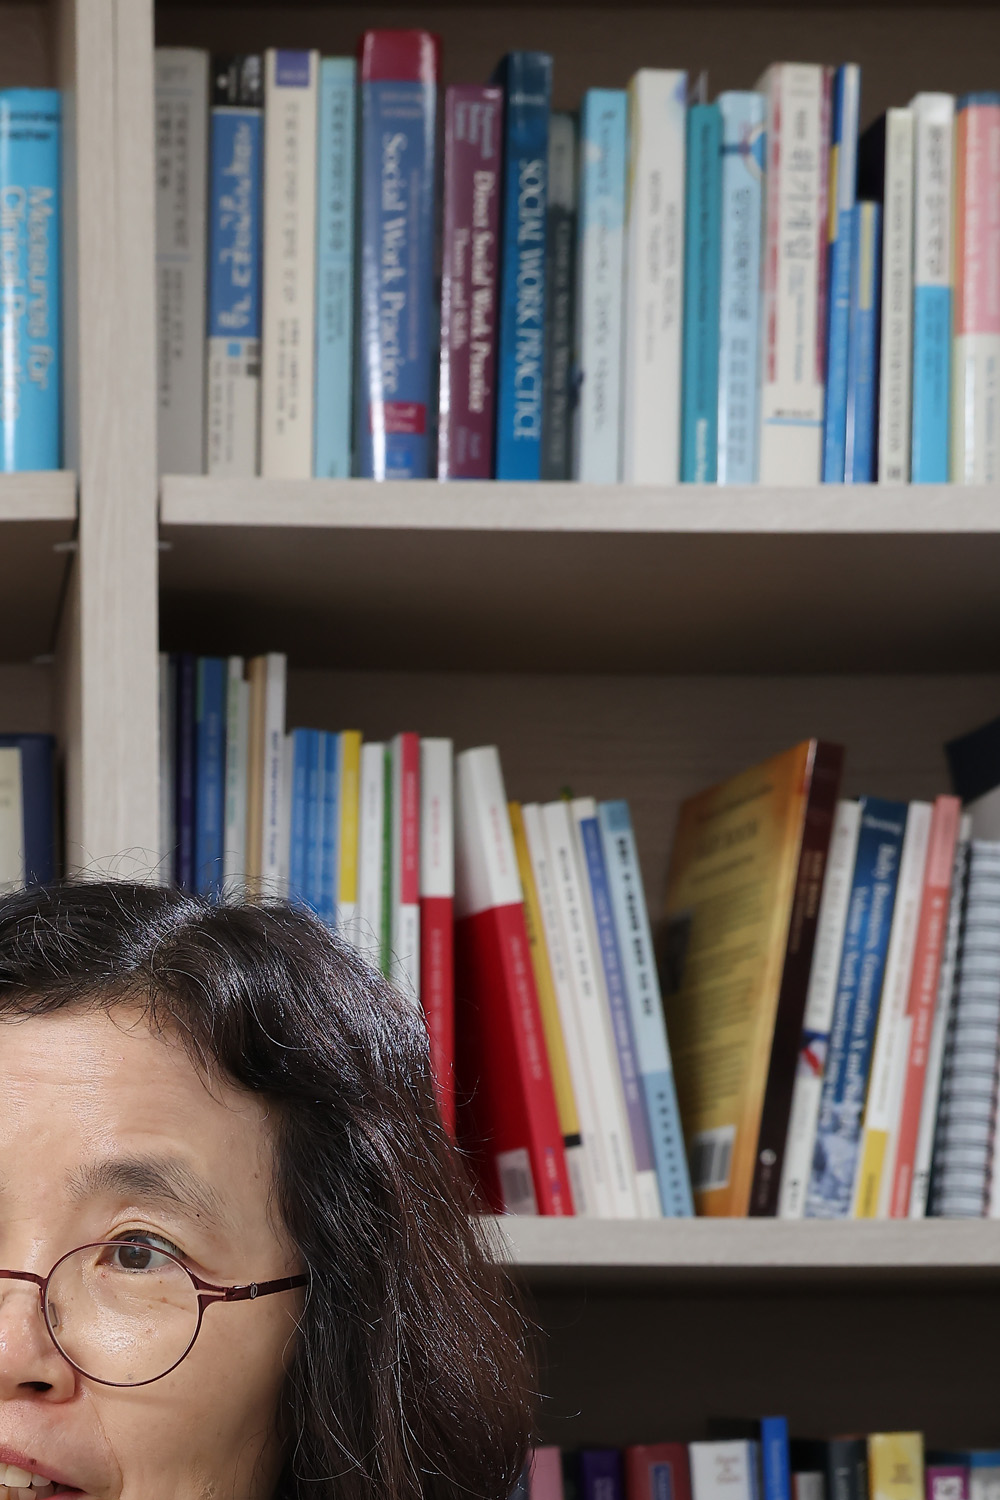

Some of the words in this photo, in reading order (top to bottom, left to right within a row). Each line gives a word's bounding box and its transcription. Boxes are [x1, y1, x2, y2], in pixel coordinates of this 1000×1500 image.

[381, 132, 407, 210] Social
[516, 160, 545, 241] SOCIAL
[26, 186, 52, 335] Measures
[381, 216, 406, 281] Work
[515, 248, 544, 325] WORK
[29, 345, 52, 388] for
[513, 328, 542, 439] PRACTICE
